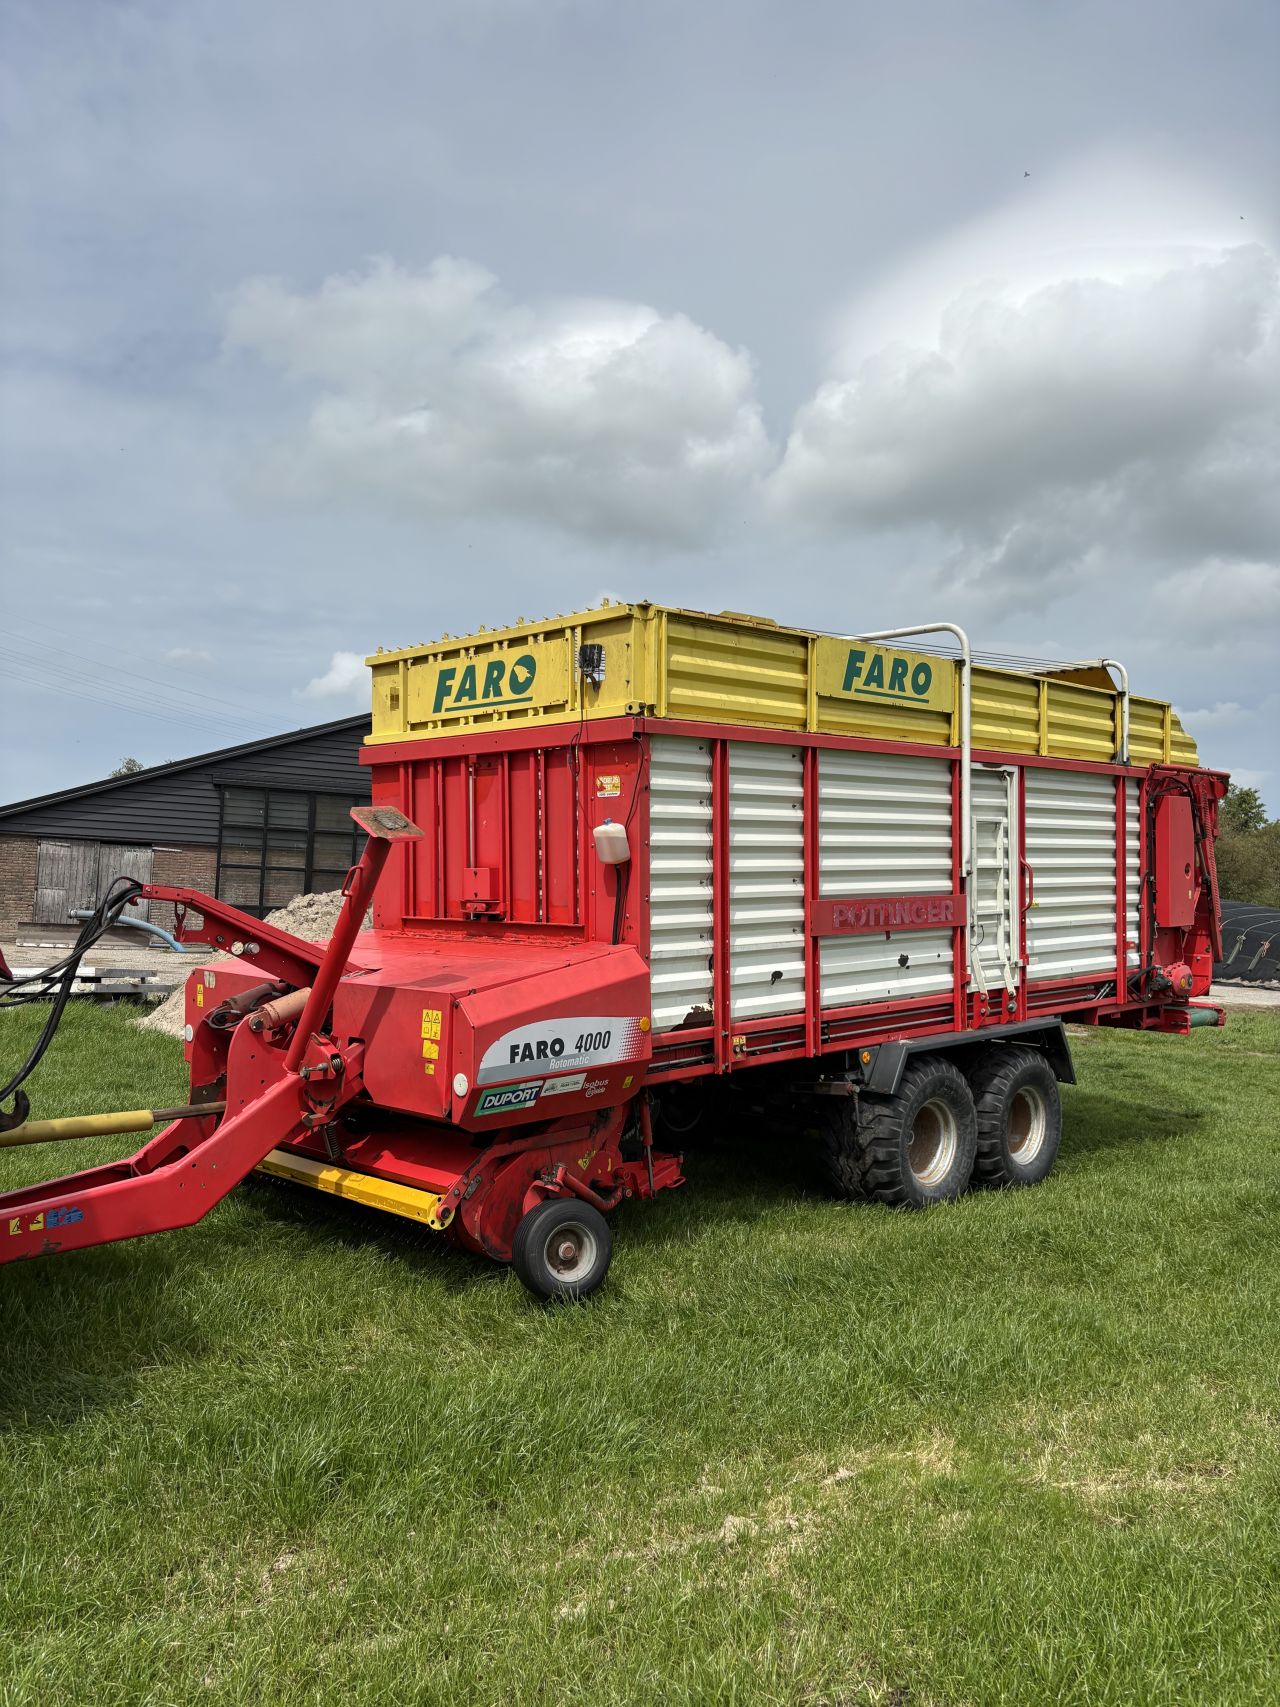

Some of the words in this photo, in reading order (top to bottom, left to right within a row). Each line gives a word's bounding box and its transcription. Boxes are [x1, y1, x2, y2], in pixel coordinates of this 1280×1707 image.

[432, 654, 537, 714] FARO
[842, 649, 933, 696] FARO
[509, 1037, 565, 1064] FARO
[574, 1030, 612, 1053] 4000
[549, 1054, 590, 1070] Rotomatic
[483, 1087, 540, 1109] DUPORT
[582, 1079, 609, 1089] Isobus
